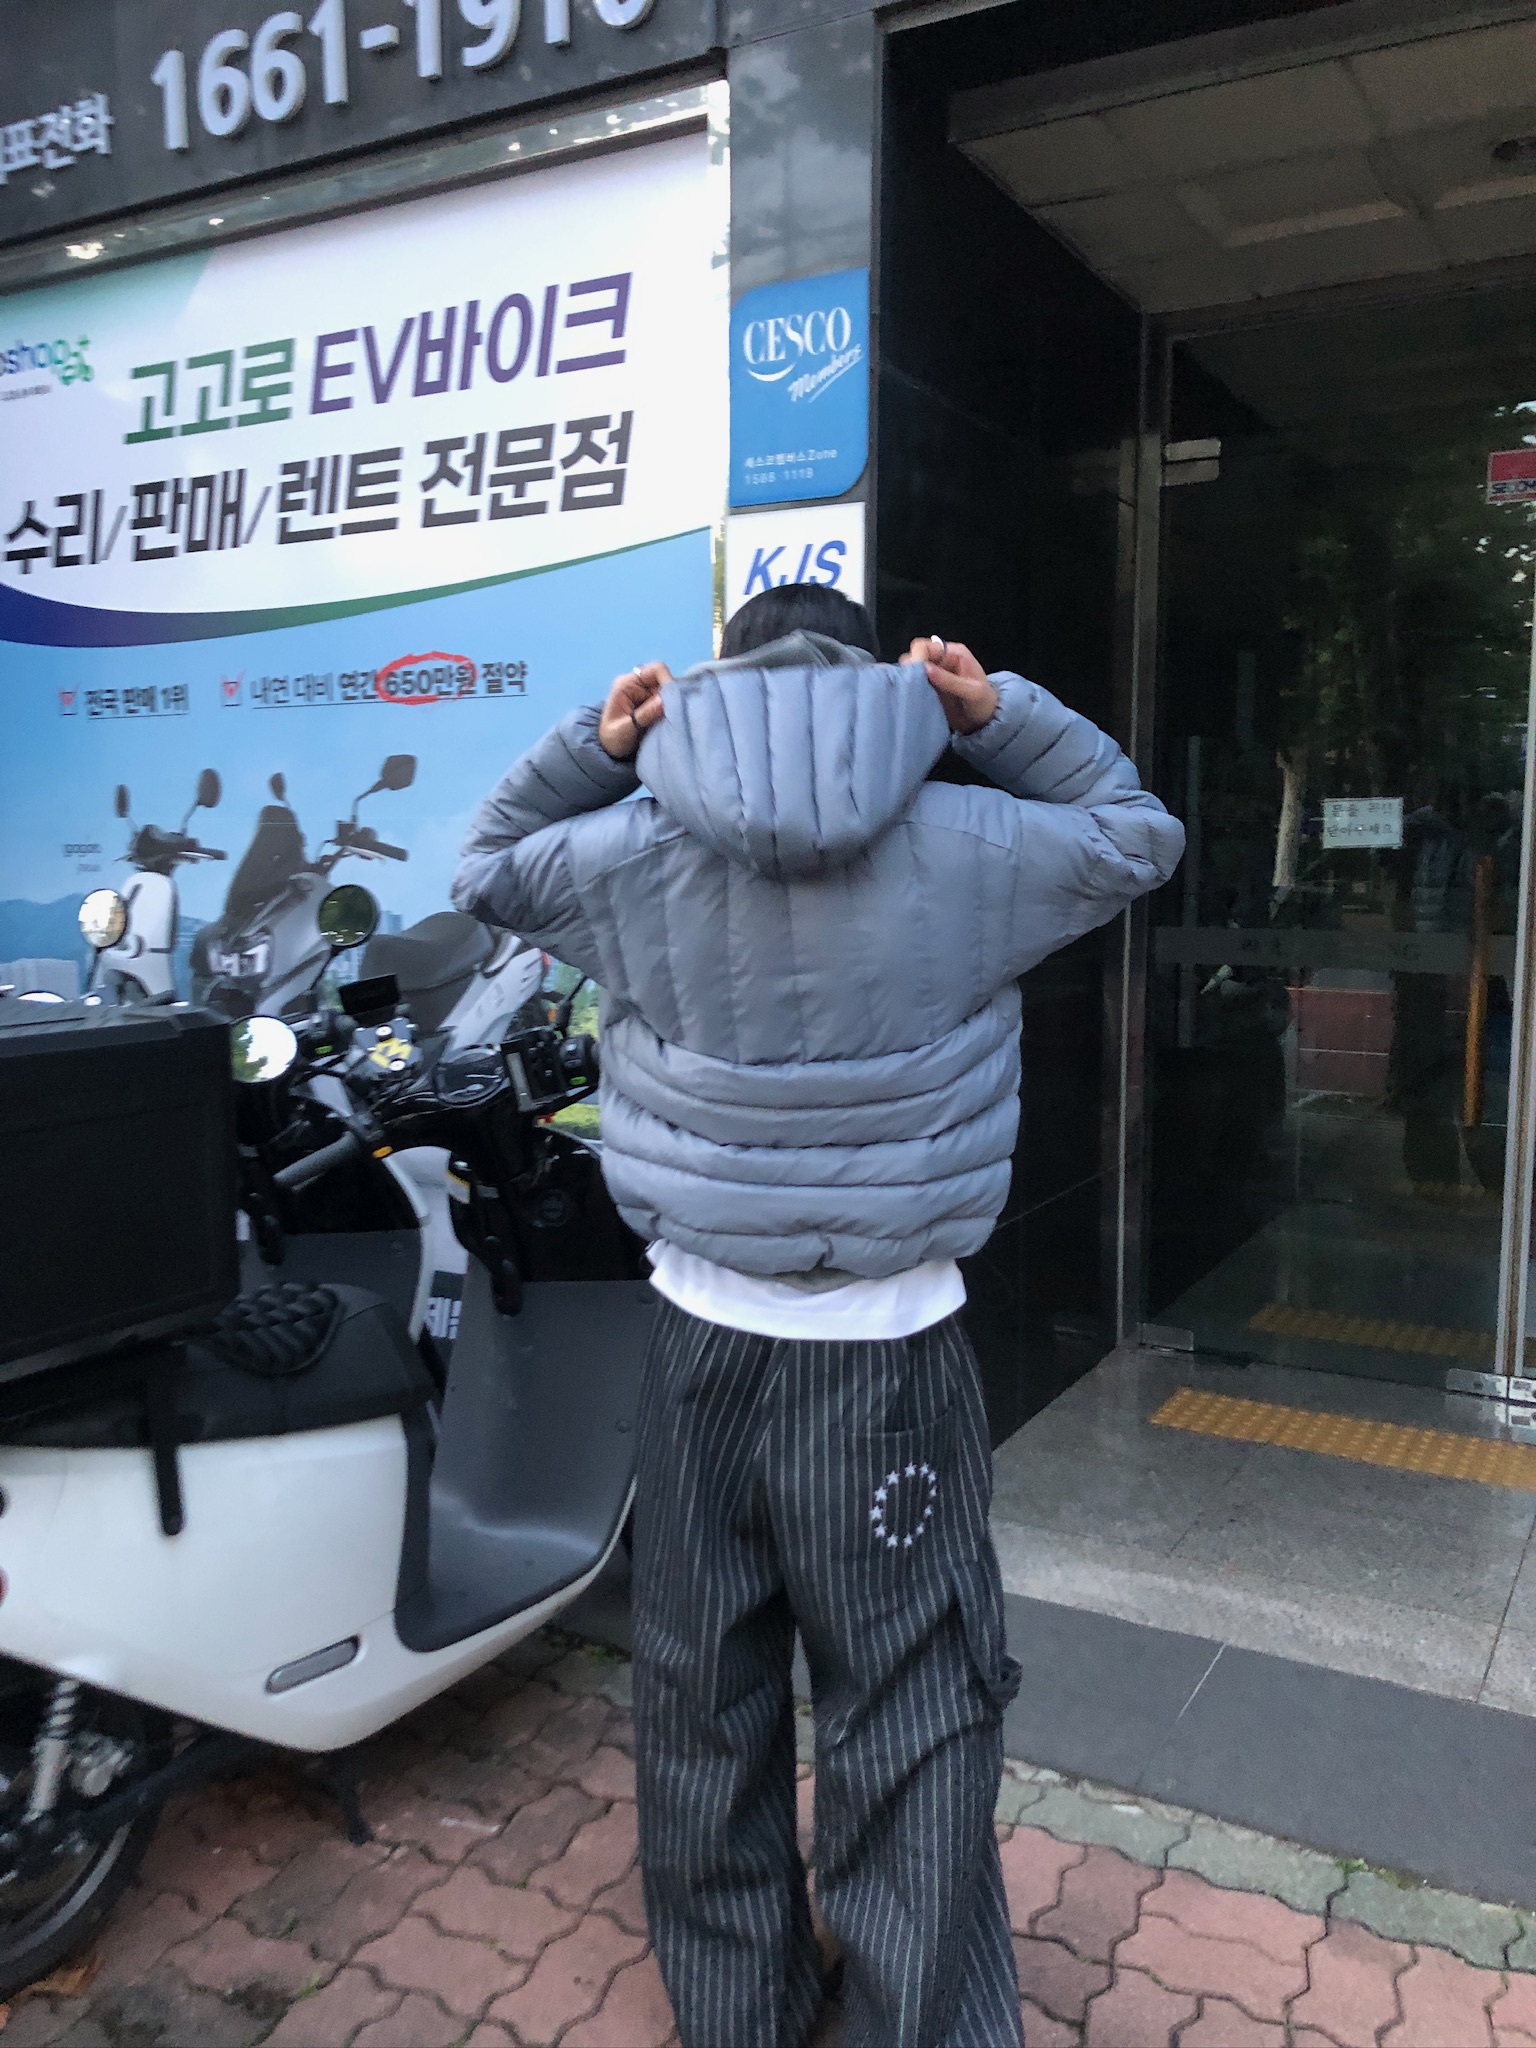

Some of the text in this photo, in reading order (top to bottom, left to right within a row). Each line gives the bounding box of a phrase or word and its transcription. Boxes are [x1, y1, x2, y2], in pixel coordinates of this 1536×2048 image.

[0, 0, 654, 184] 표전화 1661-19
[123, 271, 633, 445] 고고로 EV바이크
[743, 307, 852, 366] CESCO
[419, 410, 634, 528] 전문점
[481, 660, 528, 694] 절약
